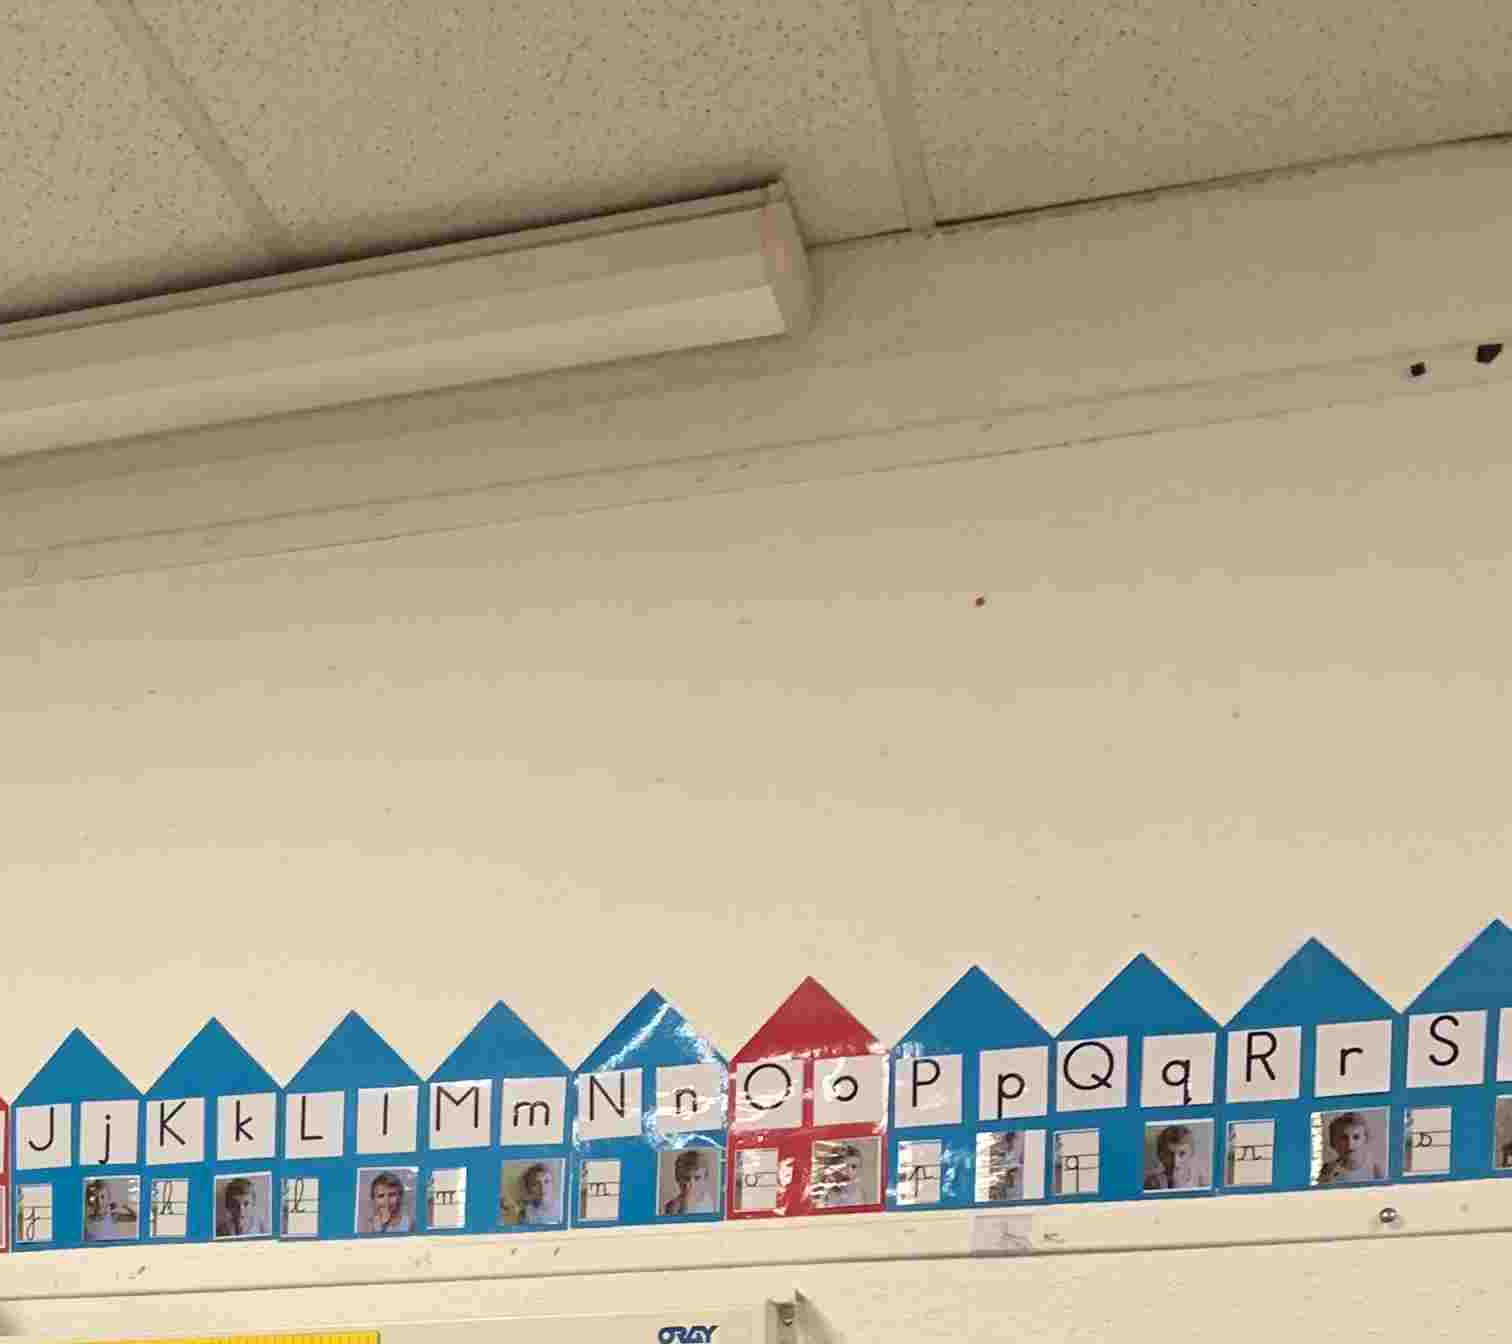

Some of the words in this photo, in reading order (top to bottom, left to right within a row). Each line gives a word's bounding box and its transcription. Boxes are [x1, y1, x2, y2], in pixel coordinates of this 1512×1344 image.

[1245, 1032, 1278, 1083] R
[1340, 1041, 1364, 1077] r
[1428, 1015, 1461, 1068] S
[589, 1075, 627, 1121] N
[676, 1082, 698, 1115] n
[744, 1062, 793, 1111] O
[832, 1074, 859, 1103] o
[912, 1059, 943, 1109] P
[998, 1071, 1026, 1119] p
[1063, 1041, 1115, 1090] Q
[1162, 1058, 1193, 1105] q
[160, 1101, 186, 1147] K
[235, 1100, 255, 1141] k
[300, 1096, 323, 1142] L
[435, 1086, 480, 1131] M
[512, 1099, 551, 1127] m
[29, 1106, 56, 1152] J
[98, 1113, 112, 1164] j
